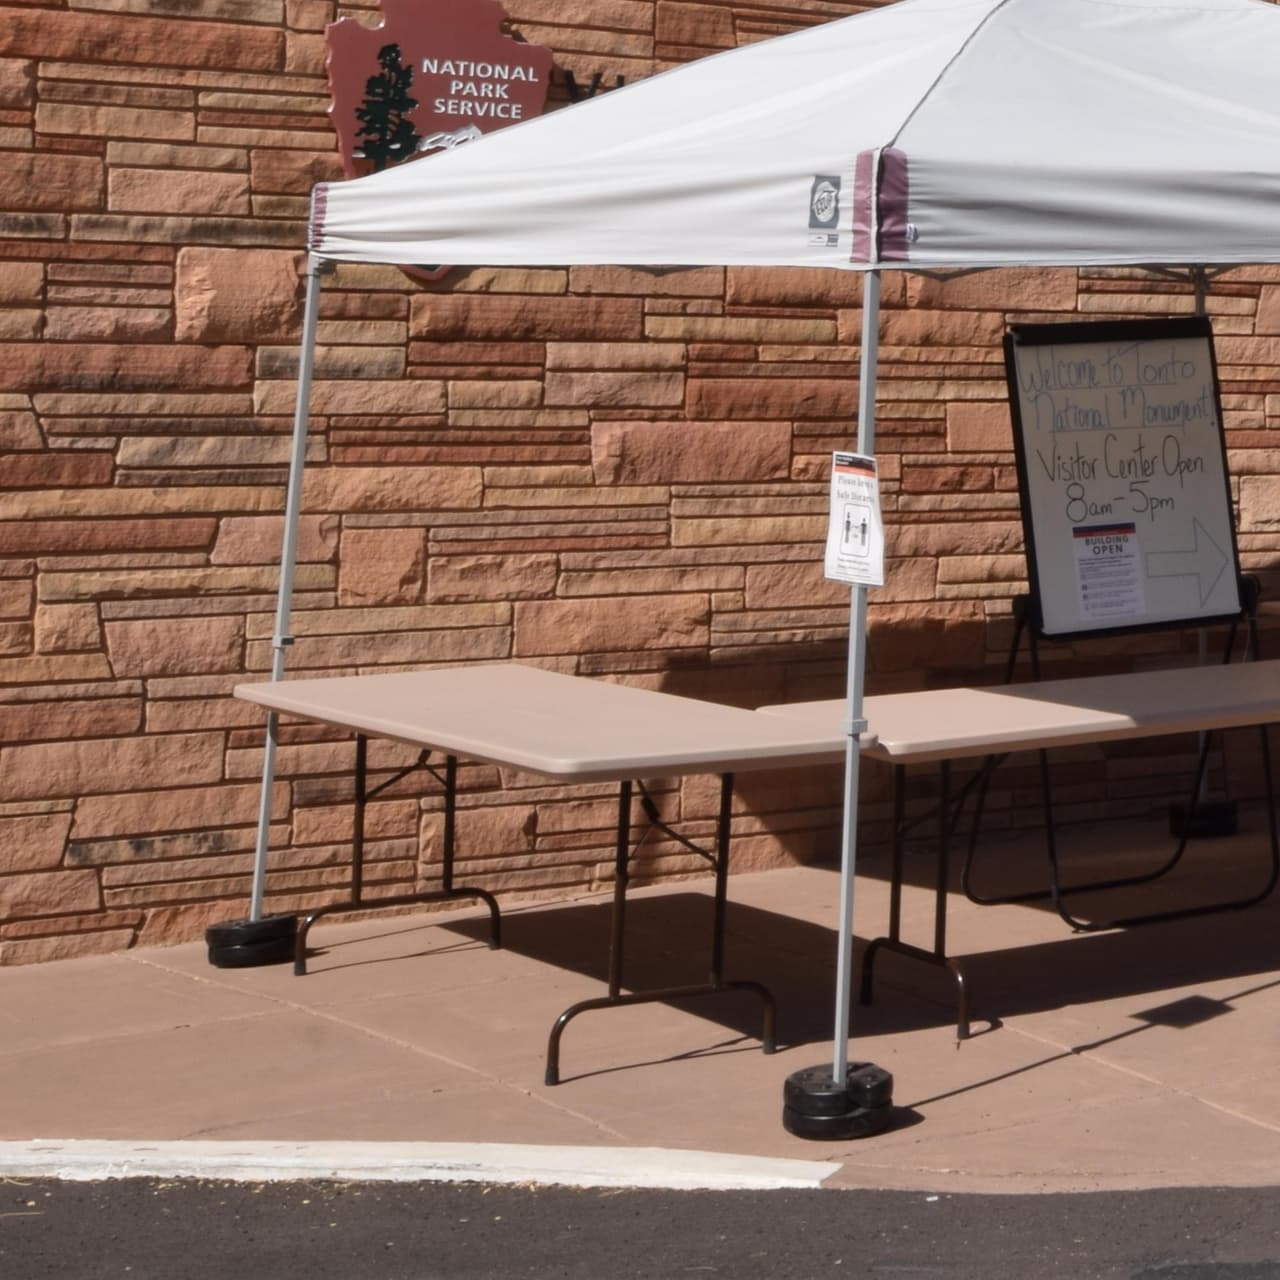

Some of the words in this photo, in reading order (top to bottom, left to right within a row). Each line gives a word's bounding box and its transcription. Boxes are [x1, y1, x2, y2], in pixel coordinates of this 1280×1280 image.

[422, 58, 539, 82] NATIONAL
[450, 80, 509, 99] PARK
[433, 98, 523, 119] SERVICE
[1016, 343, 1100, 394] Welcome
[1102, 345, 1125, 385] to
[1117, 342, 1197, 386] Tonto
[1028, 391, 1112, 433] National
[1036, 433, 1099, 482] Visitor
[1104, 433, 1158, 480] Center
[1161, 434, 1204, 489] Open
[1084, 535, 1129, 546] BUILDING
[1092, 543, 1123, 555] OPEN
